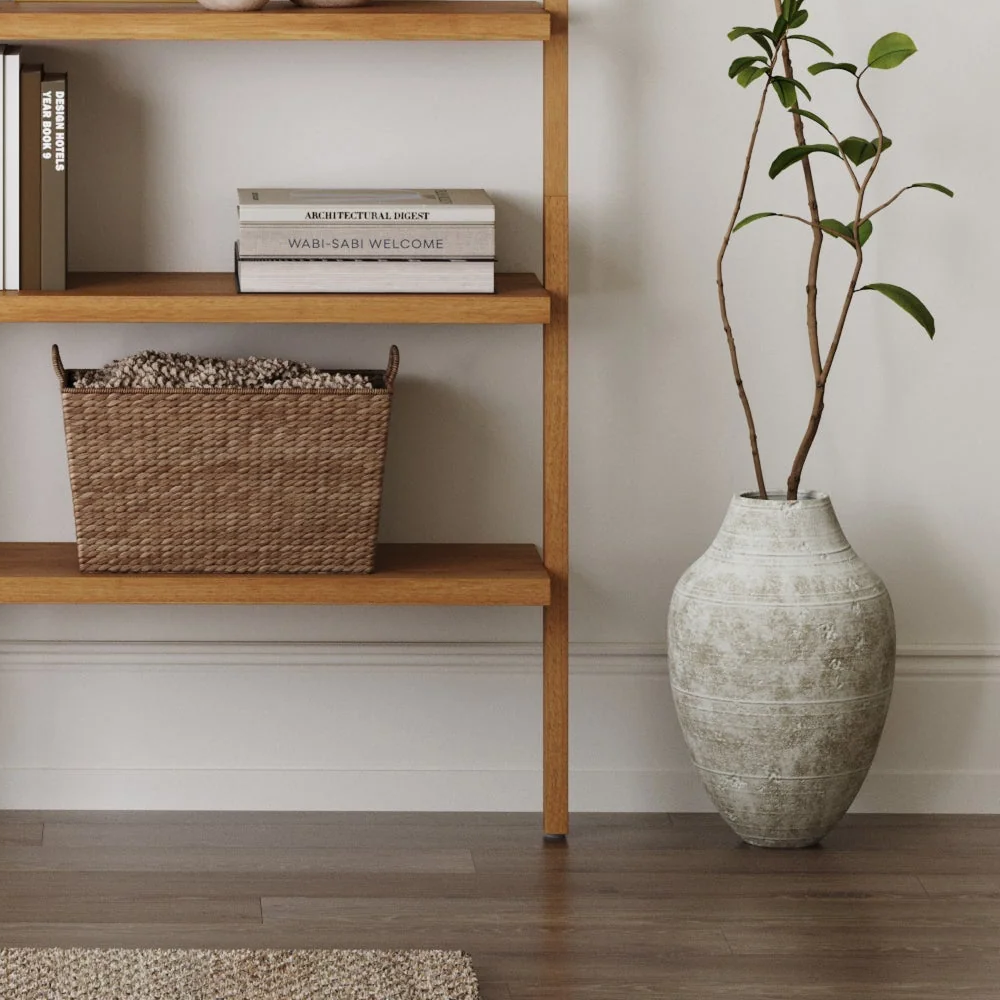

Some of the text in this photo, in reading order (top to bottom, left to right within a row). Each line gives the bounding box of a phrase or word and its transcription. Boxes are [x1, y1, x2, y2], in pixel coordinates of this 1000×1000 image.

[42, 90, 52, 118] YEAR
[42, 120, 52, 150] BOOK
[55, 90, 65, 171] DESIGN HOTELS
[305, 211, 430, 220] ARCHITECTURAL DIGEST
[288, 239, 445, 249] WABI-SABI WELCOME
